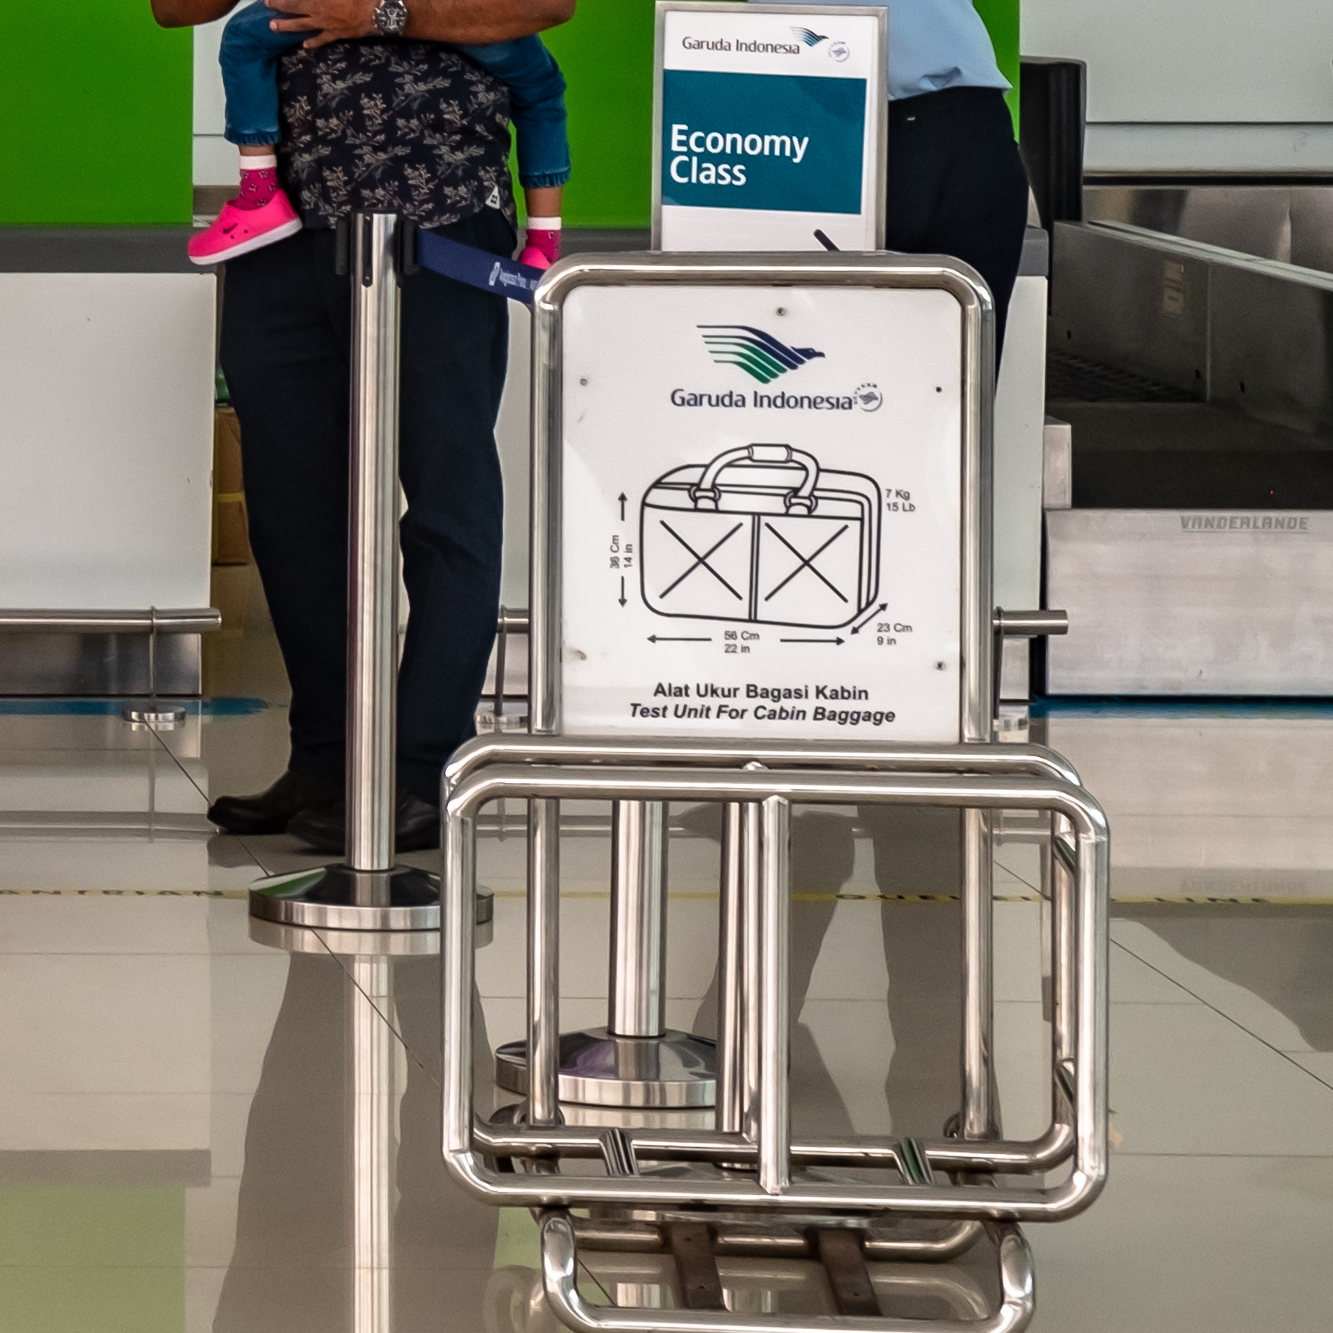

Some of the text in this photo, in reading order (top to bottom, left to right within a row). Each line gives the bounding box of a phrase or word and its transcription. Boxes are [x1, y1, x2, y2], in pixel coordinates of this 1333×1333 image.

[682, 36, 800, 55] Garuda Indonesia
[671, 124, 810, 164] Economy
[670, 155, 747, 187] Class
[671, 388, 853, 410] Garuda Indonesia
[885, 489, 911, 502] 7 Kg
[886, 501, 916, 512] 15 Lb
[1180, 515, 1311, 531] VANDERLANDE
[610, 534, 620, 553] Cm
[623, 544, 633, 568] 14 in
[741, 631, 760, 642] Cm
[877, 623, 913, 634] 23 Cm
[724, 643, 751, 654] 22 in
[877, 635, 897, 646] 9 in
[653, 682, 869, 703] Alat Ukur Bagasi Kabin
[630, 703, 897, 726] Test Unit For Cabin Baggage
